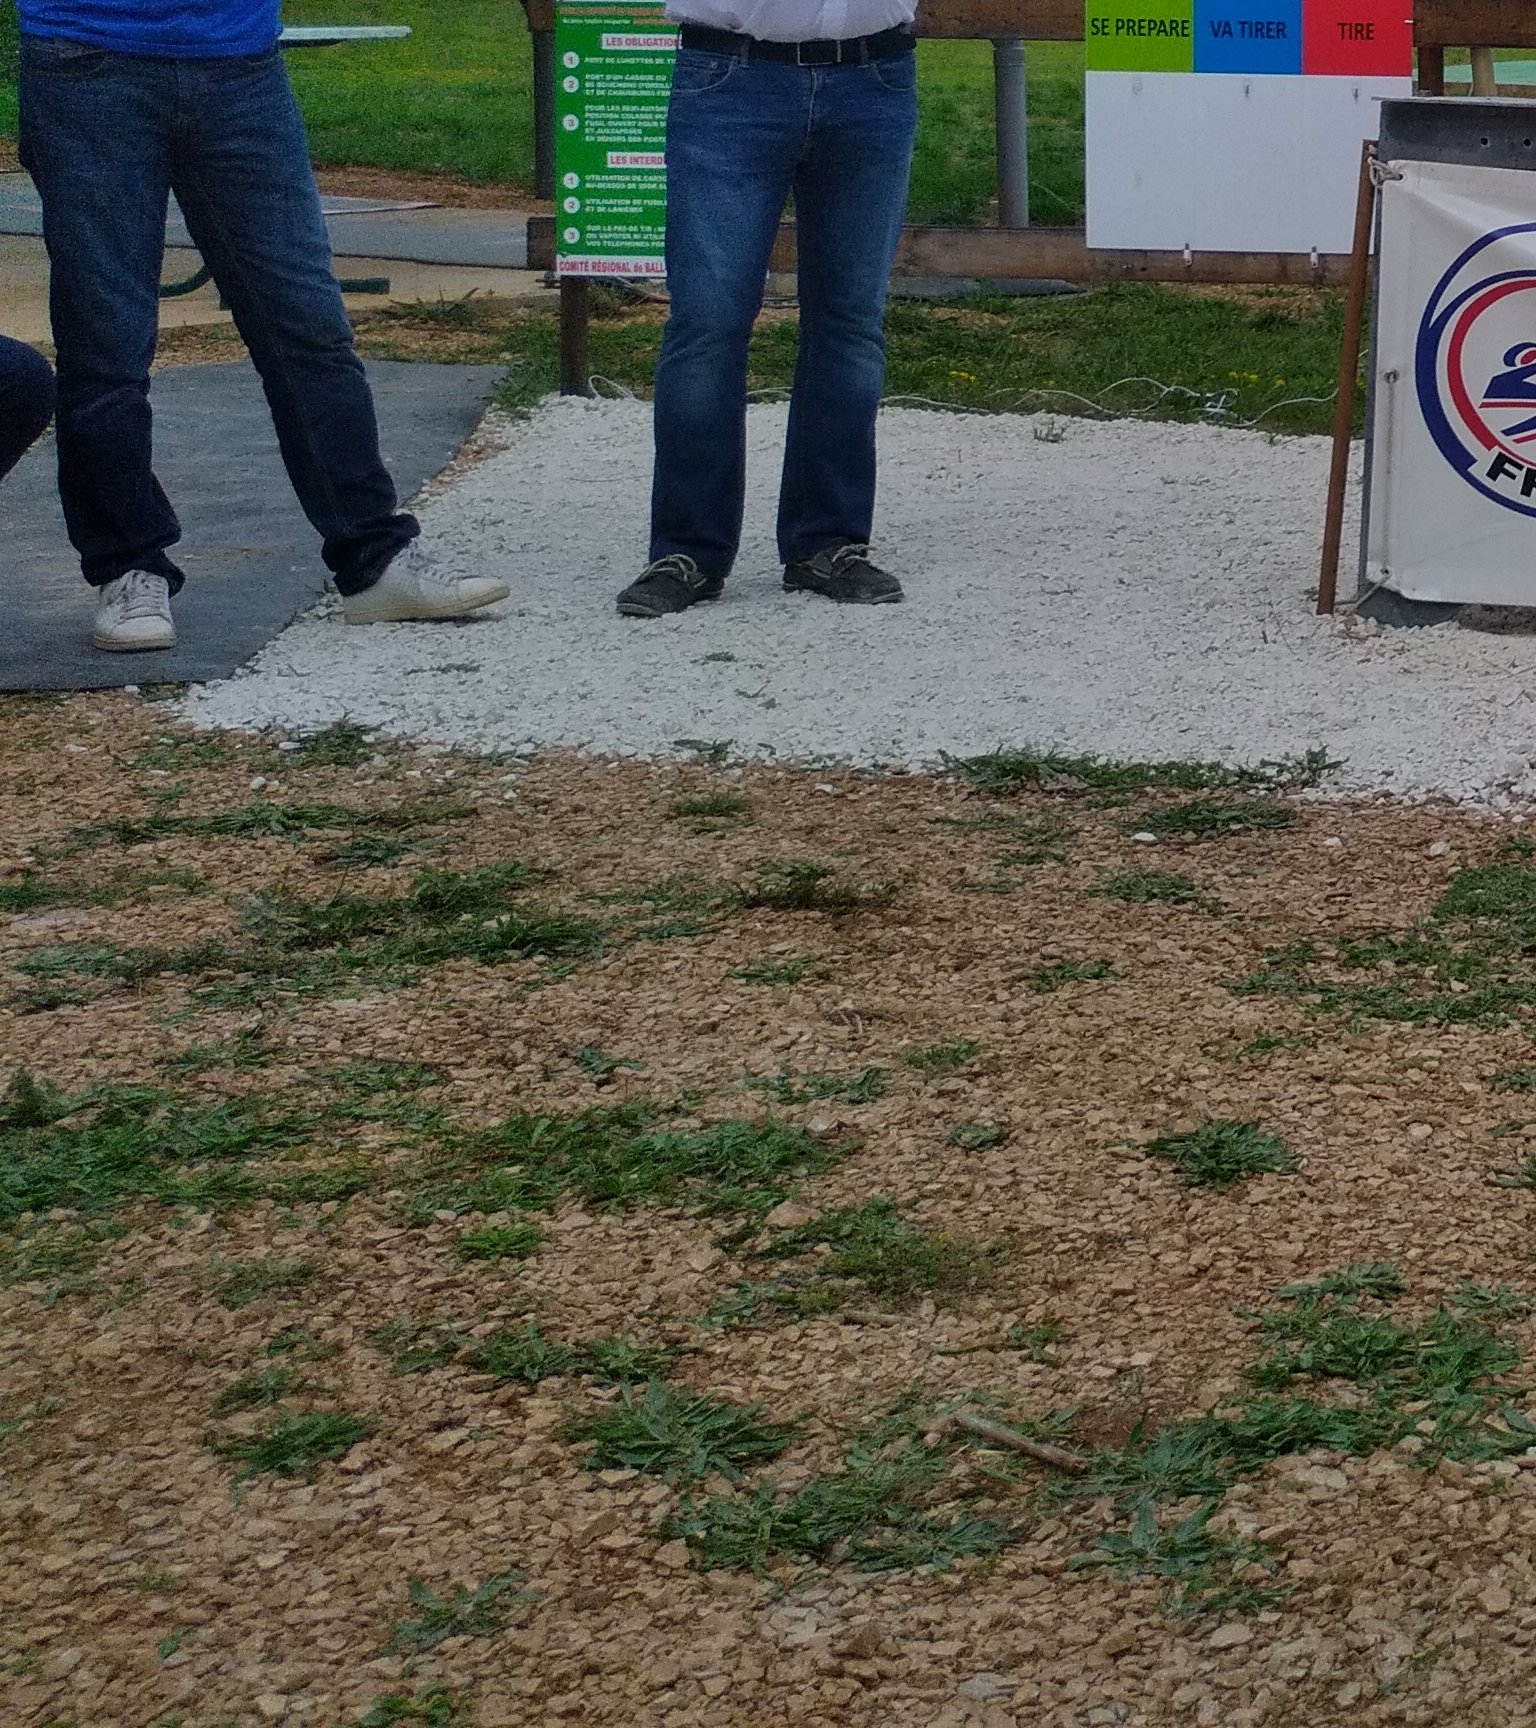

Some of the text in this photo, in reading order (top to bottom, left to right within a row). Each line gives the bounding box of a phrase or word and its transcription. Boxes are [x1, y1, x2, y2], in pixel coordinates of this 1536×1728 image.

[1091, 17, 1190, 38] SE PREPARE
[1210, 20, 1287, 40] VA TIRER
[1337, 22, 1375, 40] TIRE
[606, 38, 623, 46] LES
[568, 80, 574, 88] 2
[610, 156, 664, 165] LES INTERD
